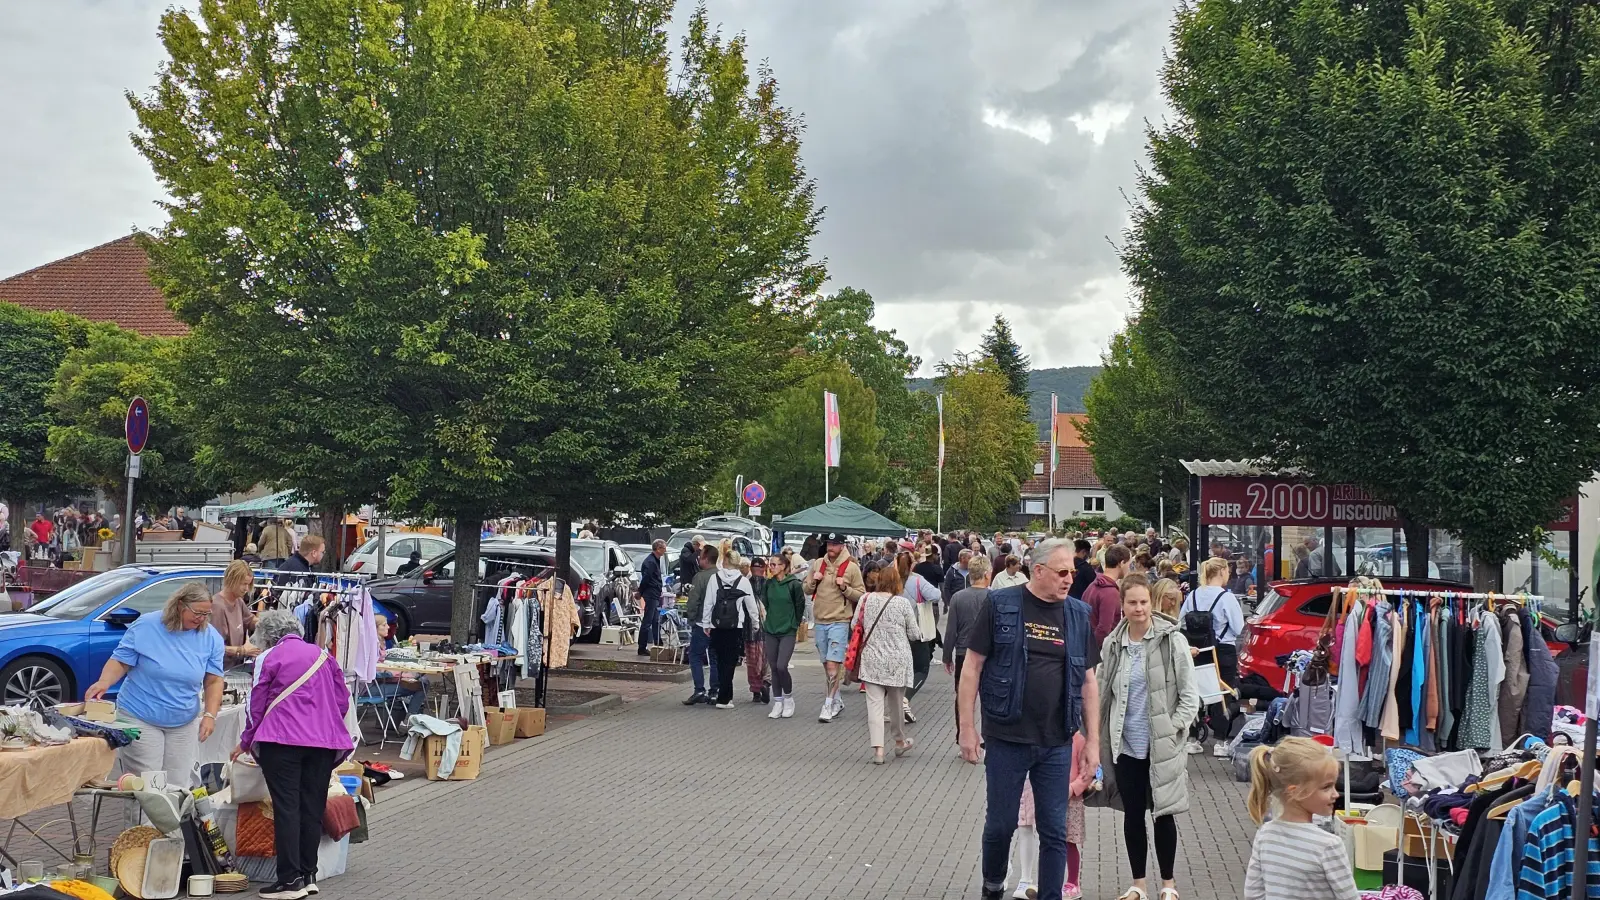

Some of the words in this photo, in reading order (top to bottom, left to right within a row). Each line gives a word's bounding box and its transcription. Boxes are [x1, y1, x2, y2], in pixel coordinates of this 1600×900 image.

[1209, 500, 1241, 518] ÜBER
[1246, 483, 1329, 519] 2.000
[1333, 484, 1383, 501] ARTIK
